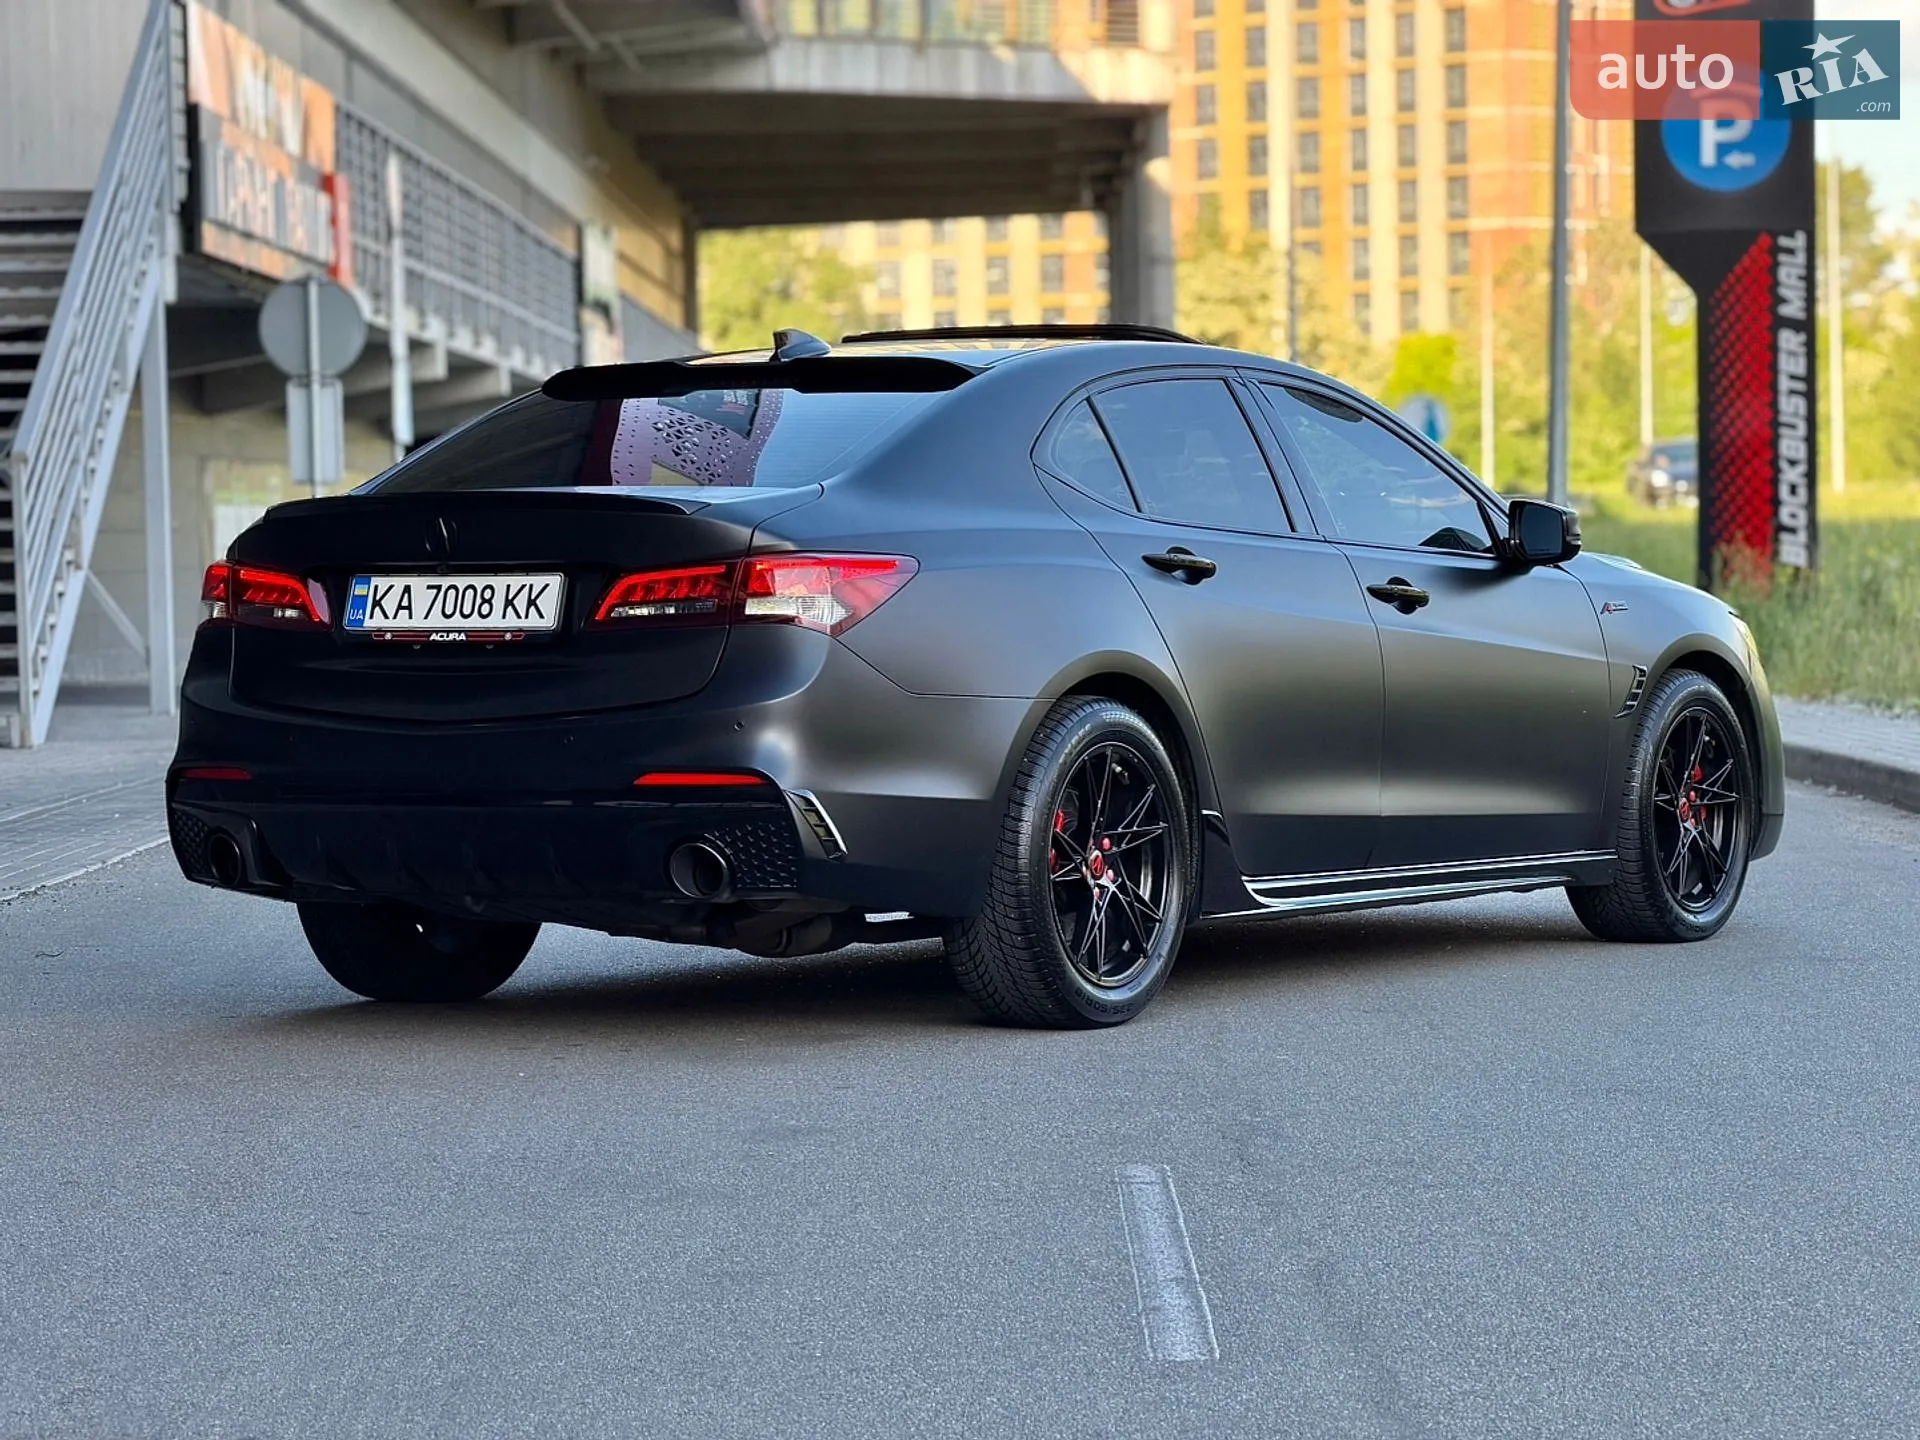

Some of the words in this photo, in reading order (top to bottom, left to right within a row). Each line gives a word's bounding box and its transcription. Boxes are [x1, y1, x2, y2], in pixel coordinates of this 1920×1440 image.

[1700, 99, 1752, 168] P
[1776, 230, 1808, 320] MALL
[1776, 327, 1808, 567] BLOCKBUSTER
[350, 609, 364, 621] UA
[369, 584, 414, 620] KA
[423, 583, 496, 620] 7008
[502, 583, 551, 620] KK
[429, 632, 467, 641] ACURA
